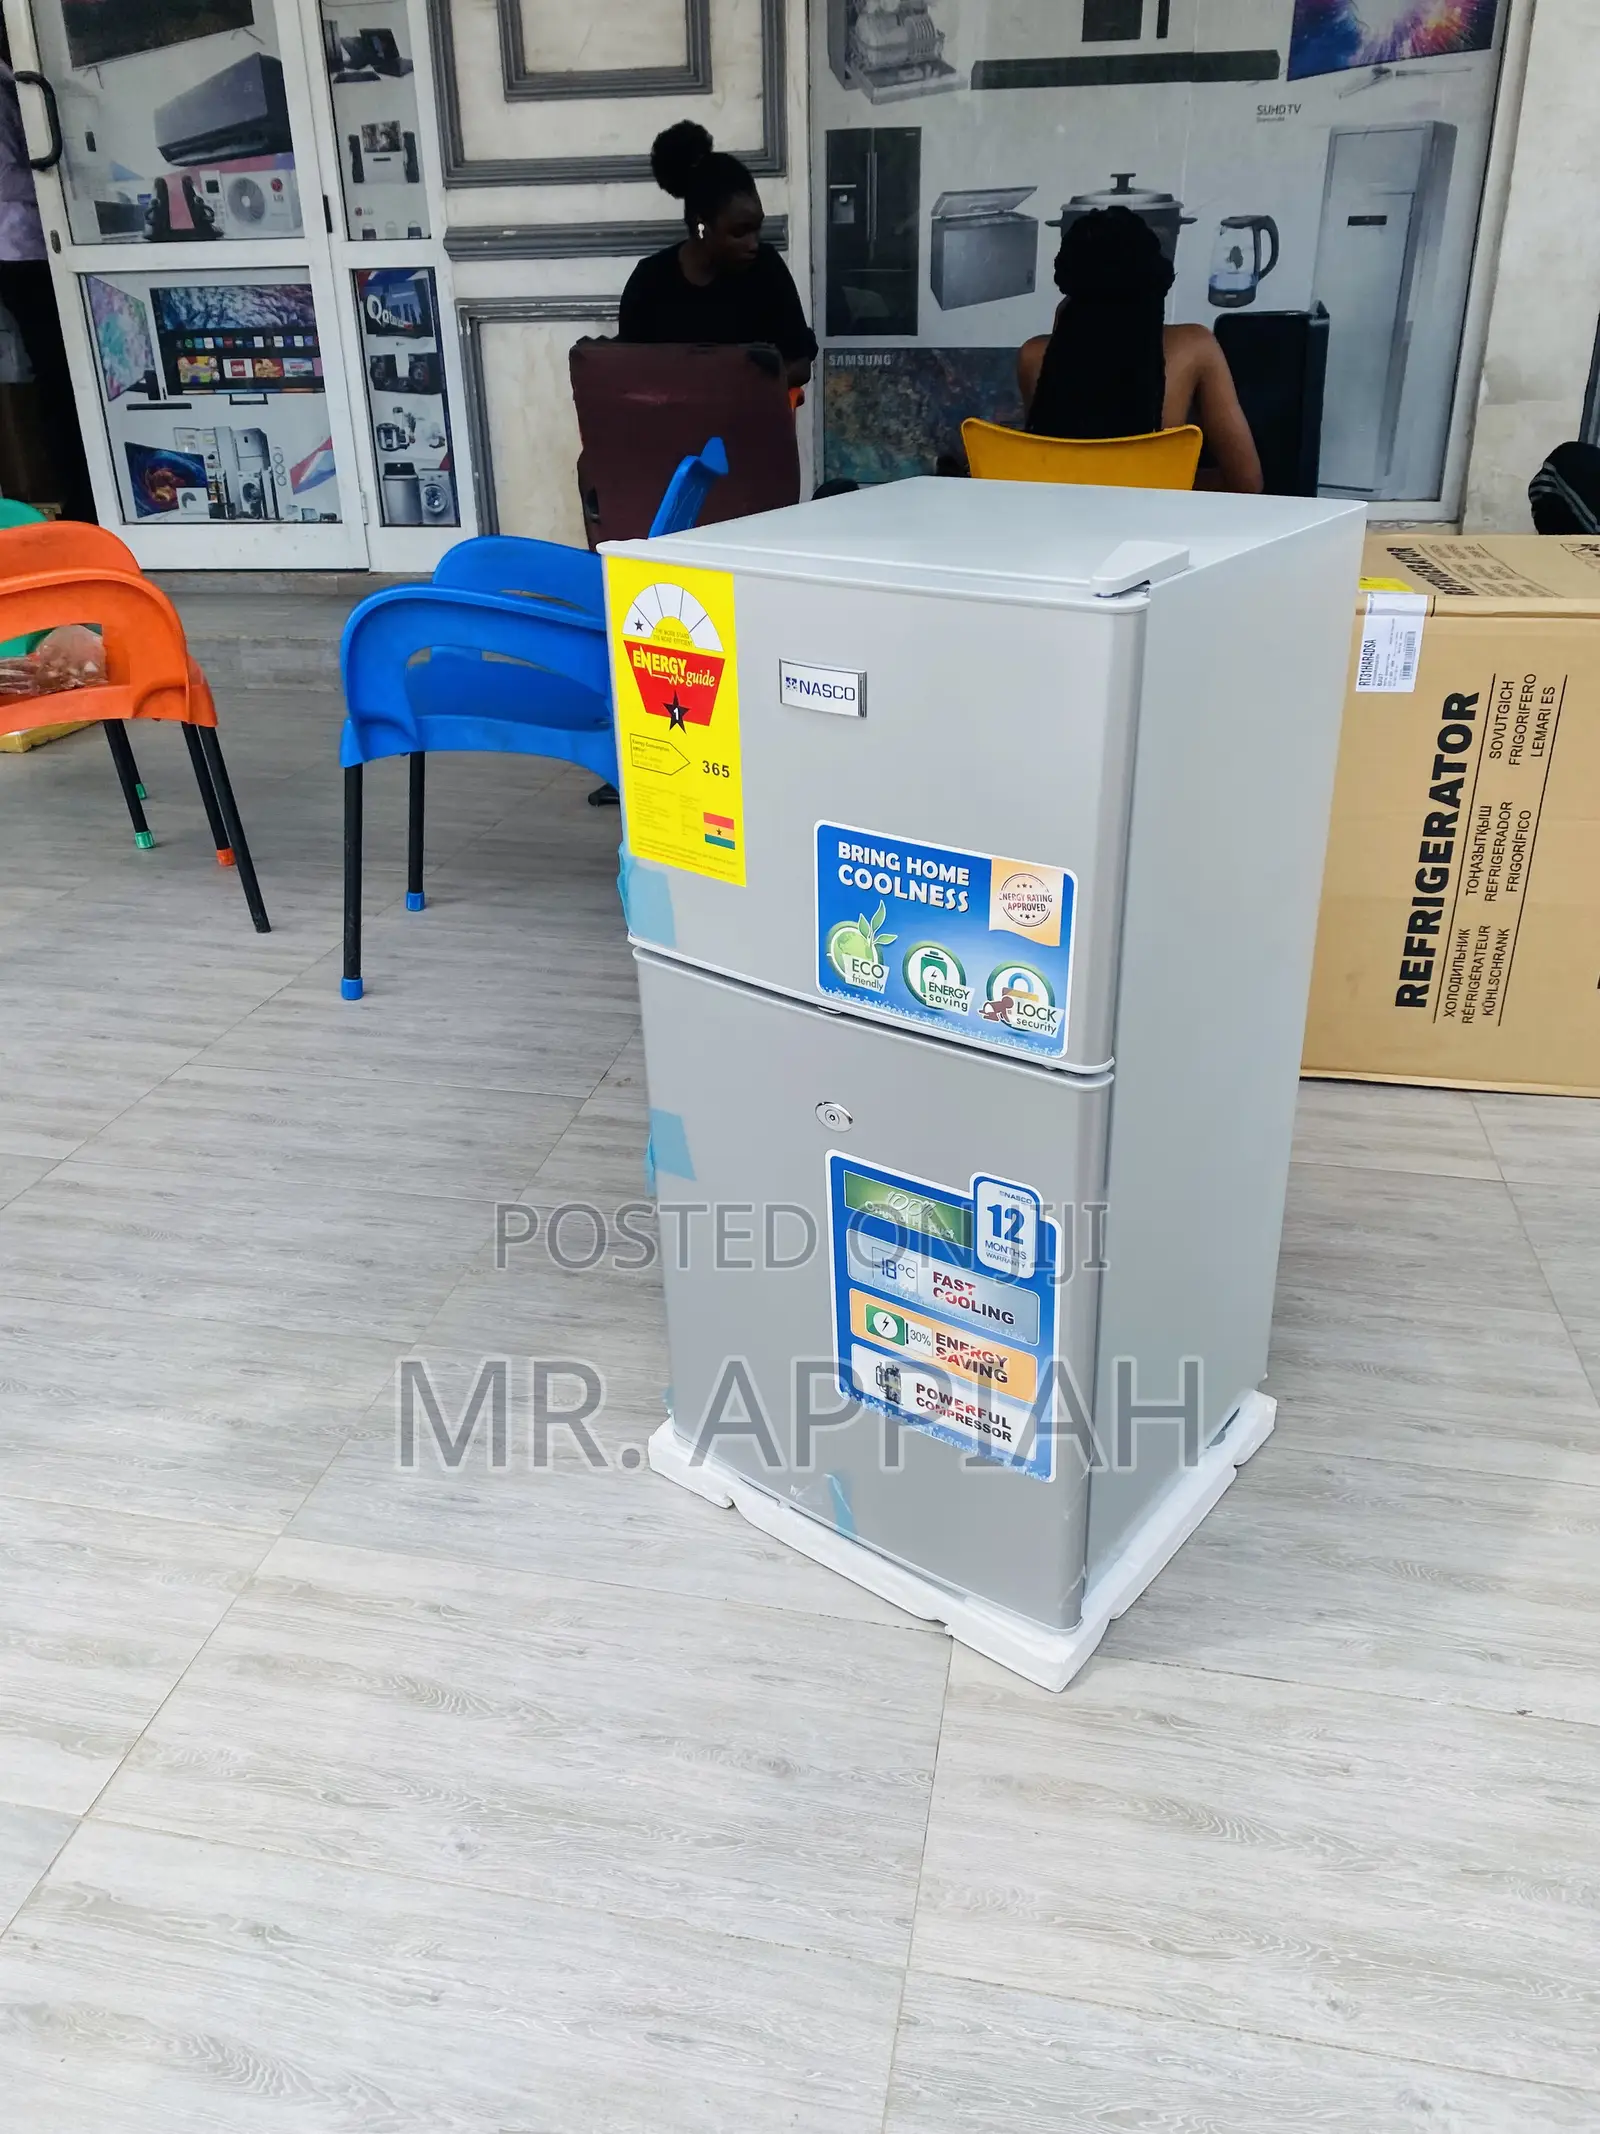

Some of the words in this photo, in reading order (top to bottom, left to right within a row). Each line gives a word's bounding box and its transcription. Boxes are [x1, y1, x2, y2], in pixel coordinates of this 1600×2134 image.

[829, 354, 892, 366] SAMSUNG
[633, 647, 687, 677] ENERGY
[686, 670, 715, 688] guide
[799, 679, 856, 702] NASCO
[673, 706, 680, 721] 1
[1489, 680, 1515, 760] SOVUTGICH
[1508, 673, 1537, 766] FRIGORIFERO
[1531, 708, 1551, 758] LEMARI
[1542, 686, 1556, 704] ES
[702, 760, 730, 778] 365
[1395, 691, 1480, 1008] REFRIGERATOR
[1485, 801, 1513, 902] REFRIGERADOR
[838, 841, 900, 871] BRING
[906, 856, 970, 887] HOME
[838, 864, 970, 914] COOLNESS
[1027, 894, 1053, 903] RATING
[1008, 903, 1046, 912] APPROVED
[852, 961, 884, 978] ECO
[1443, 927, 1471, 1018] ХОЛОДИЛЬНИК
[1462, 924, 1491, 1024] RÉFRIGÉRATEUR
[1482, 927, 1510, 1017] KÜHLSCHRANK
[852, 975, 884, 991] friendly
[928, 981, 970, 1001] ENERGY
[928, 992, 968, 1012] saving
[1016, 1001, 1057, 1023] LOCK
[1016, 1017, 1057, 1034] security
[1004, 1193, 1032, 1205] NASCO
[987, 1204, 1025, 1245] 12
[985, 1240, 1027, 1260] MONTHS
[986, 1252, 1026, 1268] WARRANTY
[933, 1271, 976, 1296] FAST
[933, 1287, 1015, 1325] COOLING
[910, 1329, 932, 1347] 30%
[936, 1332, 1008, 1368] ENERGY
[936, 1347, 1008, 1383] SAVING
[916, 1382, 1012, 1431] POWERFUL
[916, 1397, 1012, 1443] COMPRESSOR
